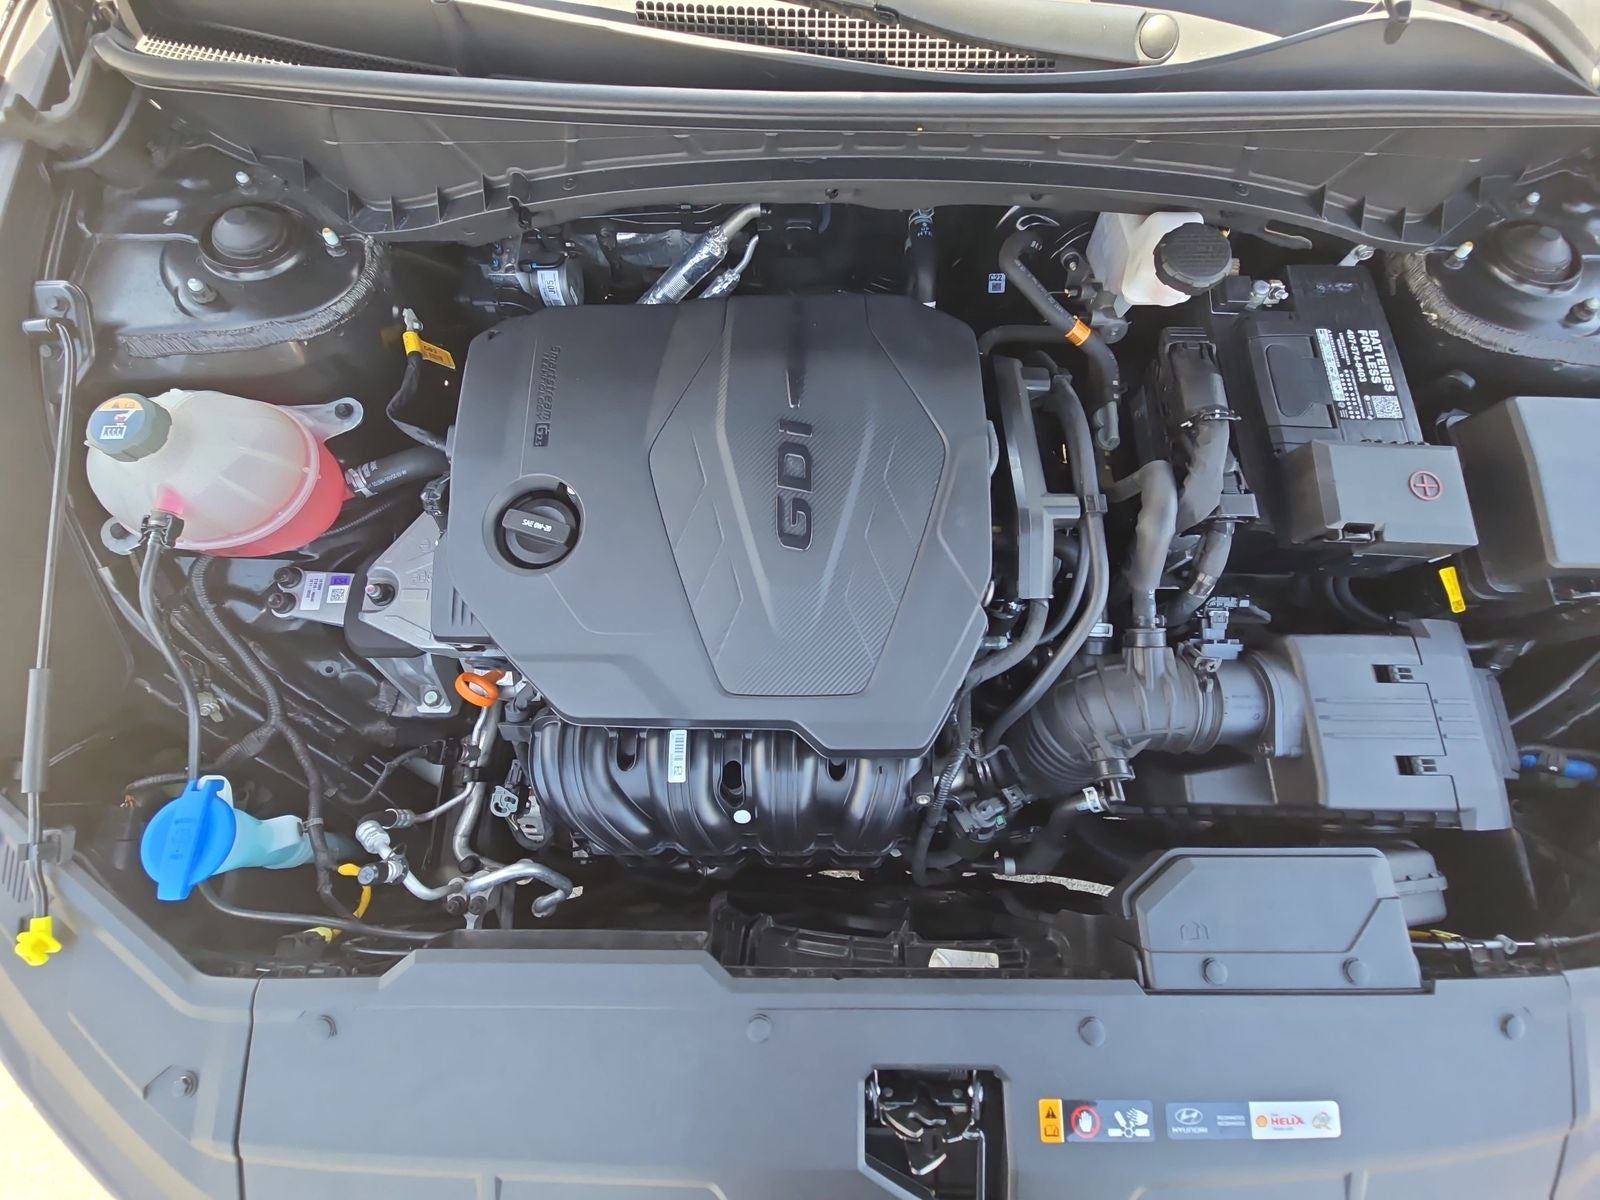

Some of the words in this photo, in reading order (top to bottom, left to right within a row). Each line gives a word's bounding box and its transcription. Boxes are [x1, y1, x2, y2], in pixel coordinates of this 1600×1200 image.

[1357, 329, 1373, 352] FOR
[1346, 328, 1368, 383] 407-574-8403
[1368, 329, 1395, 393] BATTERIES
[543, 345, 561, 420] Smartstream
[1364, 355, 1382, 384] LESS
[521, 518, 534, 528] SAE
[1171, 1126, 1208, 1134] HYUNDAI
[1271, 1113, 1305, 1126] HELIX
